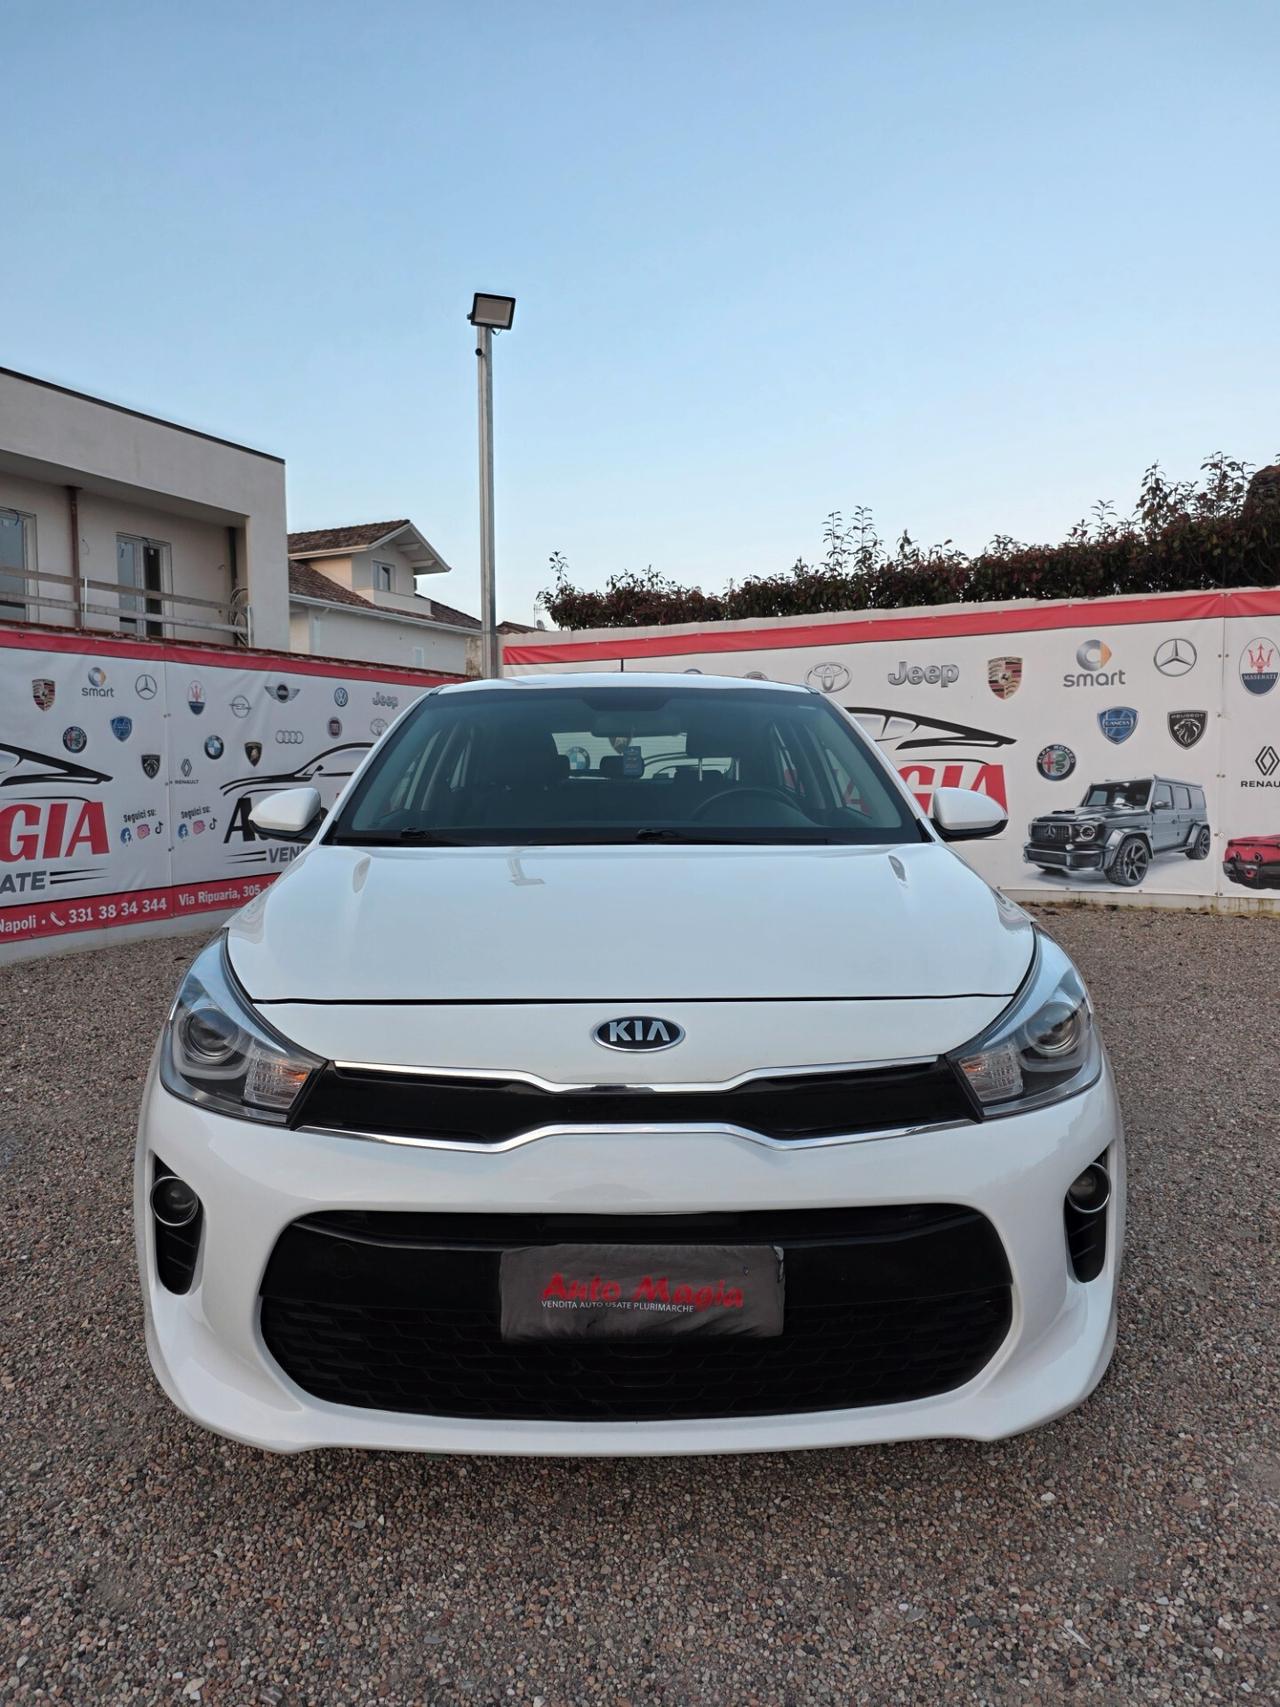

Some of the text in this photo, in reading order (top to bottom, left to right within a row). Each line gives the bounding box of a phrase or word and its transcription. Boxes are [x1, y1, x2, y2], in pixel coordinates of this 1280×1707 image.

[887, 661, 959, 688] Jeep
[1063, 669, 1126, 688] smart
[81, 686, 115, 698] smart
[372, 692, 399, 710] Jeep
[179, 893, 196, 906] Via
[69, 907, 94, 924] 331
[98, 904, 117, 919] 38
[121, 901, 138, 916] 34
[142, 897, 167, 912] 344
[608, 1020, 671, 1042] KIA
[543, 1272, 745, 1313] Auto Magia
[541, 1300, 578, 1310] VENDITA
[579, 1301, 603, 1309] AUTO
[633, 1302, 695, 1313] PLURIMARCHE
